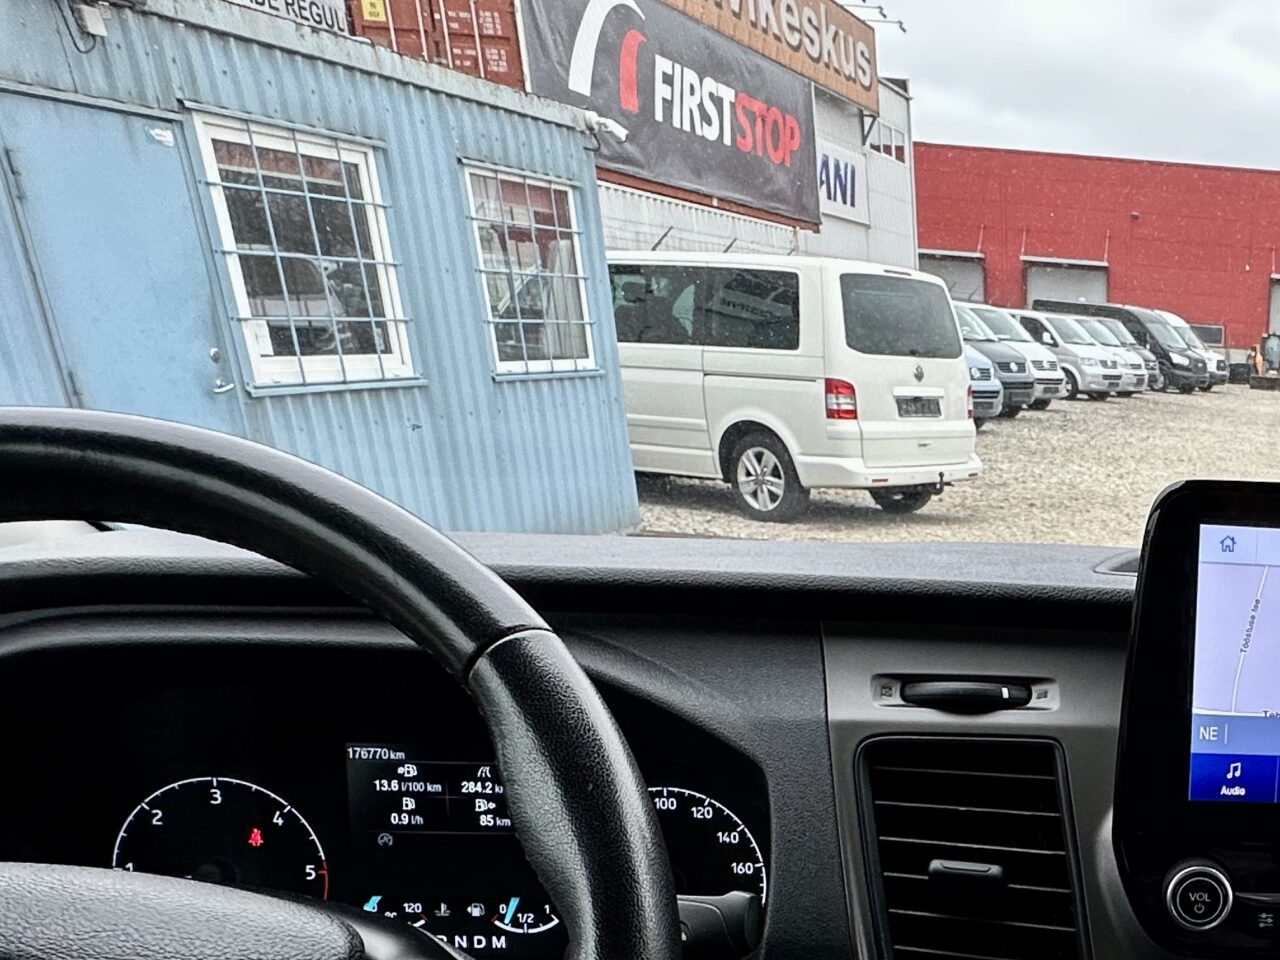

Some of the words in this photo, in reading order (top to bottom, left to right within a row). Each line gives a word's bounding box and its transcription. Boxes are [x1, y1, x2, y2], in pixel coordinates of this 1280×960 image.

[1199, 726, 1219, 741] NE
[348, 747, 388, 760] 176770
[390, 749, 406, 760] km
[374, 779, 399, 792] 13.6
[426, 782, 442, 792] km
[461, 781, 493, 794] 284.2
[1220, 785, 1246, 796] Audio
[210, 788, 223, 805] 3
[654, 798, 677, 810] 100
[151, 809, 163, 826] 2
[272, 811, 285, 826] 4
[391, 812, 409, 825] 0.9
[691, 806, 714, 819] 120
[479, 814, 494, 827] 85
[496, 817, 512, 827] km
[717, 832, 739, 844] 140
[305, 865, 317, 880] 5
[731, 862, 754, 875] 160
[1188, 892, 1212, 902] VOL
[403, 902, 423, 914] 120
[499, 903, 508, 915] 0
[543, 904, 551, 914] 1
[517, 913, 535, 924] 1/2
[455, 935, 468, 949] N
[474, 935, 487, 949] D
[492, 935, 507, 949] M
